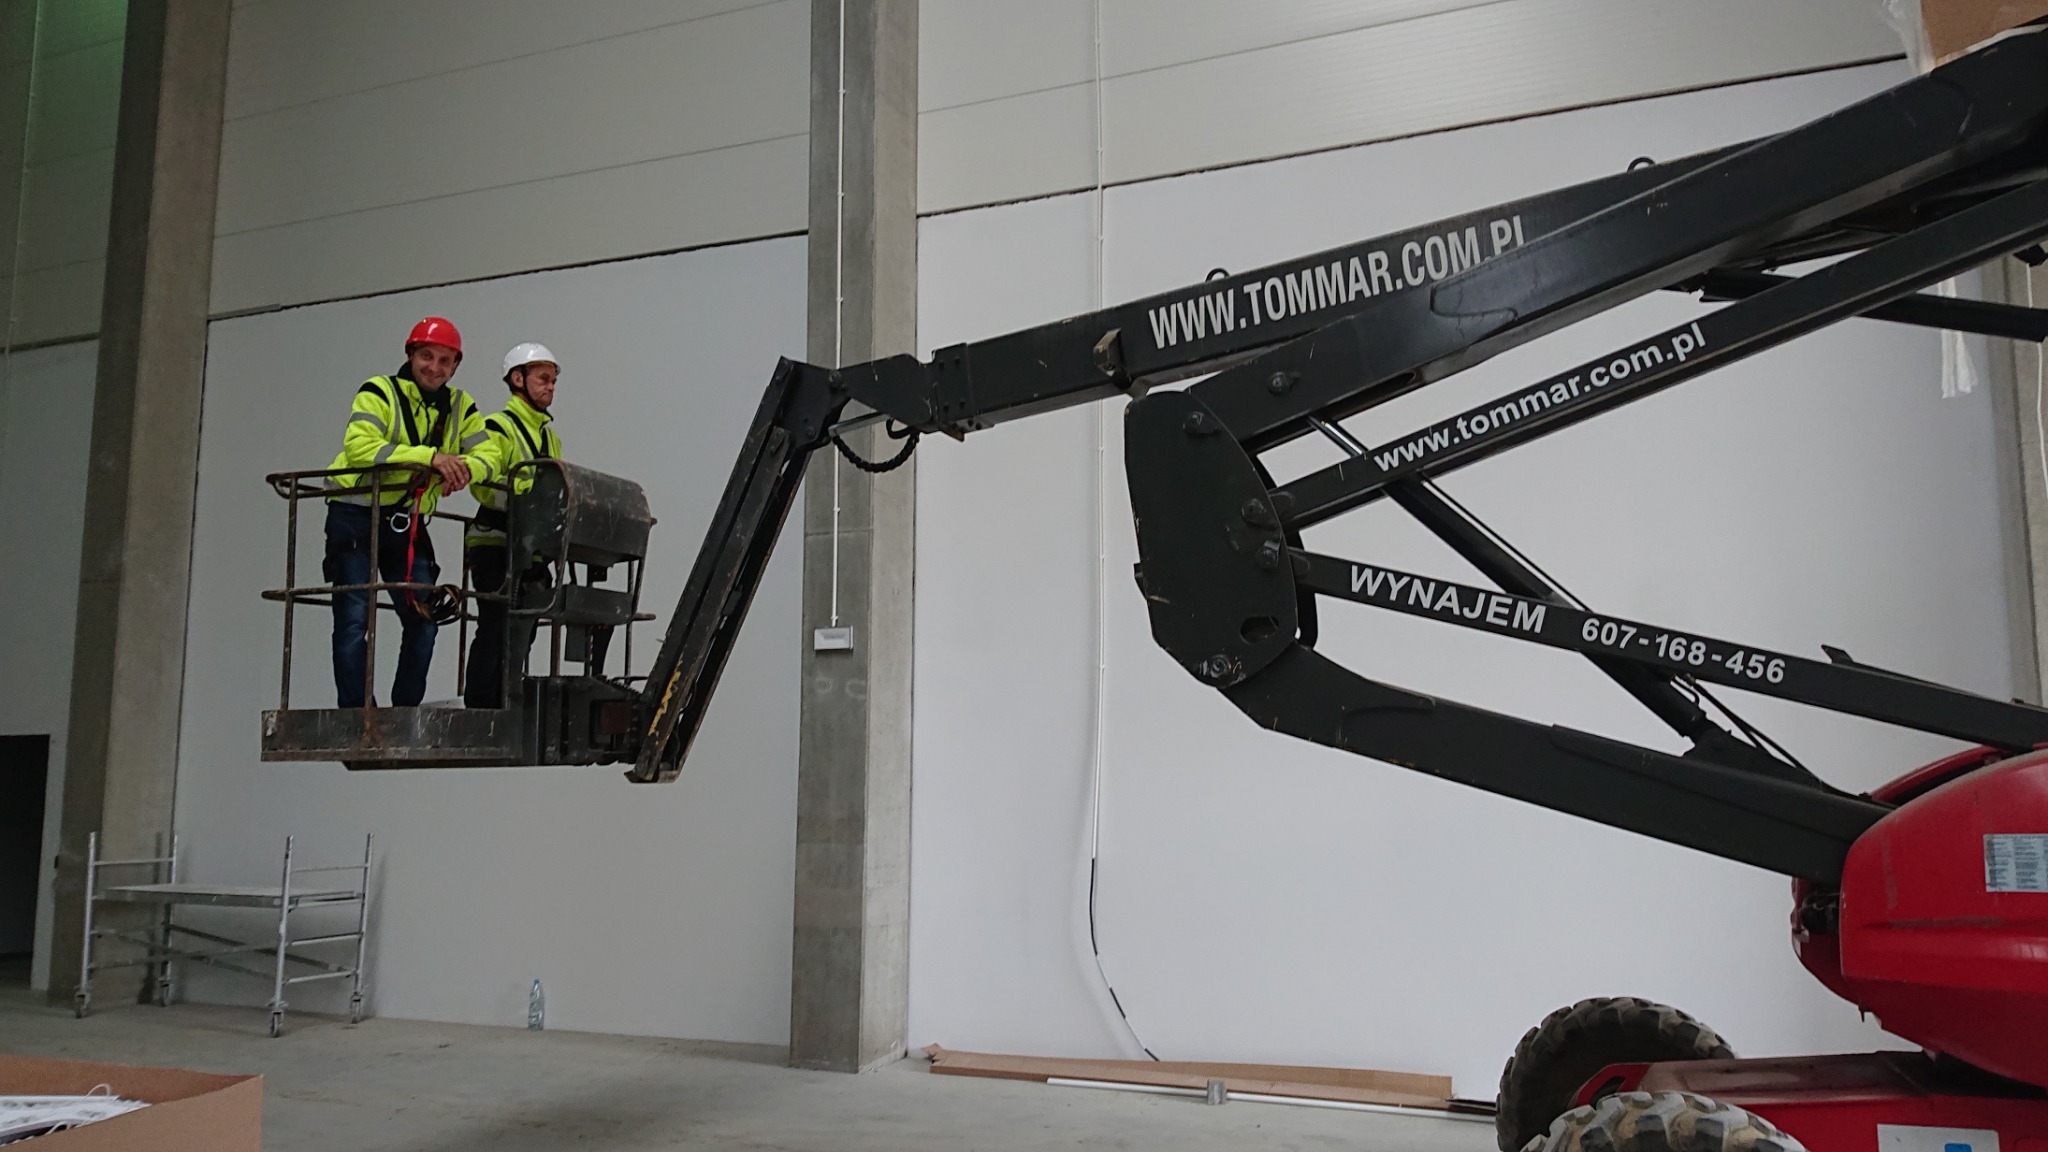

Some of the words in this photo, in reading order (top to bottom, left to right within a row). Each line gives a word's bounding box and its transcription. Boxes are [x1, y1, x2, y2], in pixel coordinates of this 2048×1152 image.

[1373, 323, 1707, 472] www.tommar.com.pl
[1351, 564, 1547, 634] WYNAJEM
[1582, 618, 1786, 683] 607-168-456
